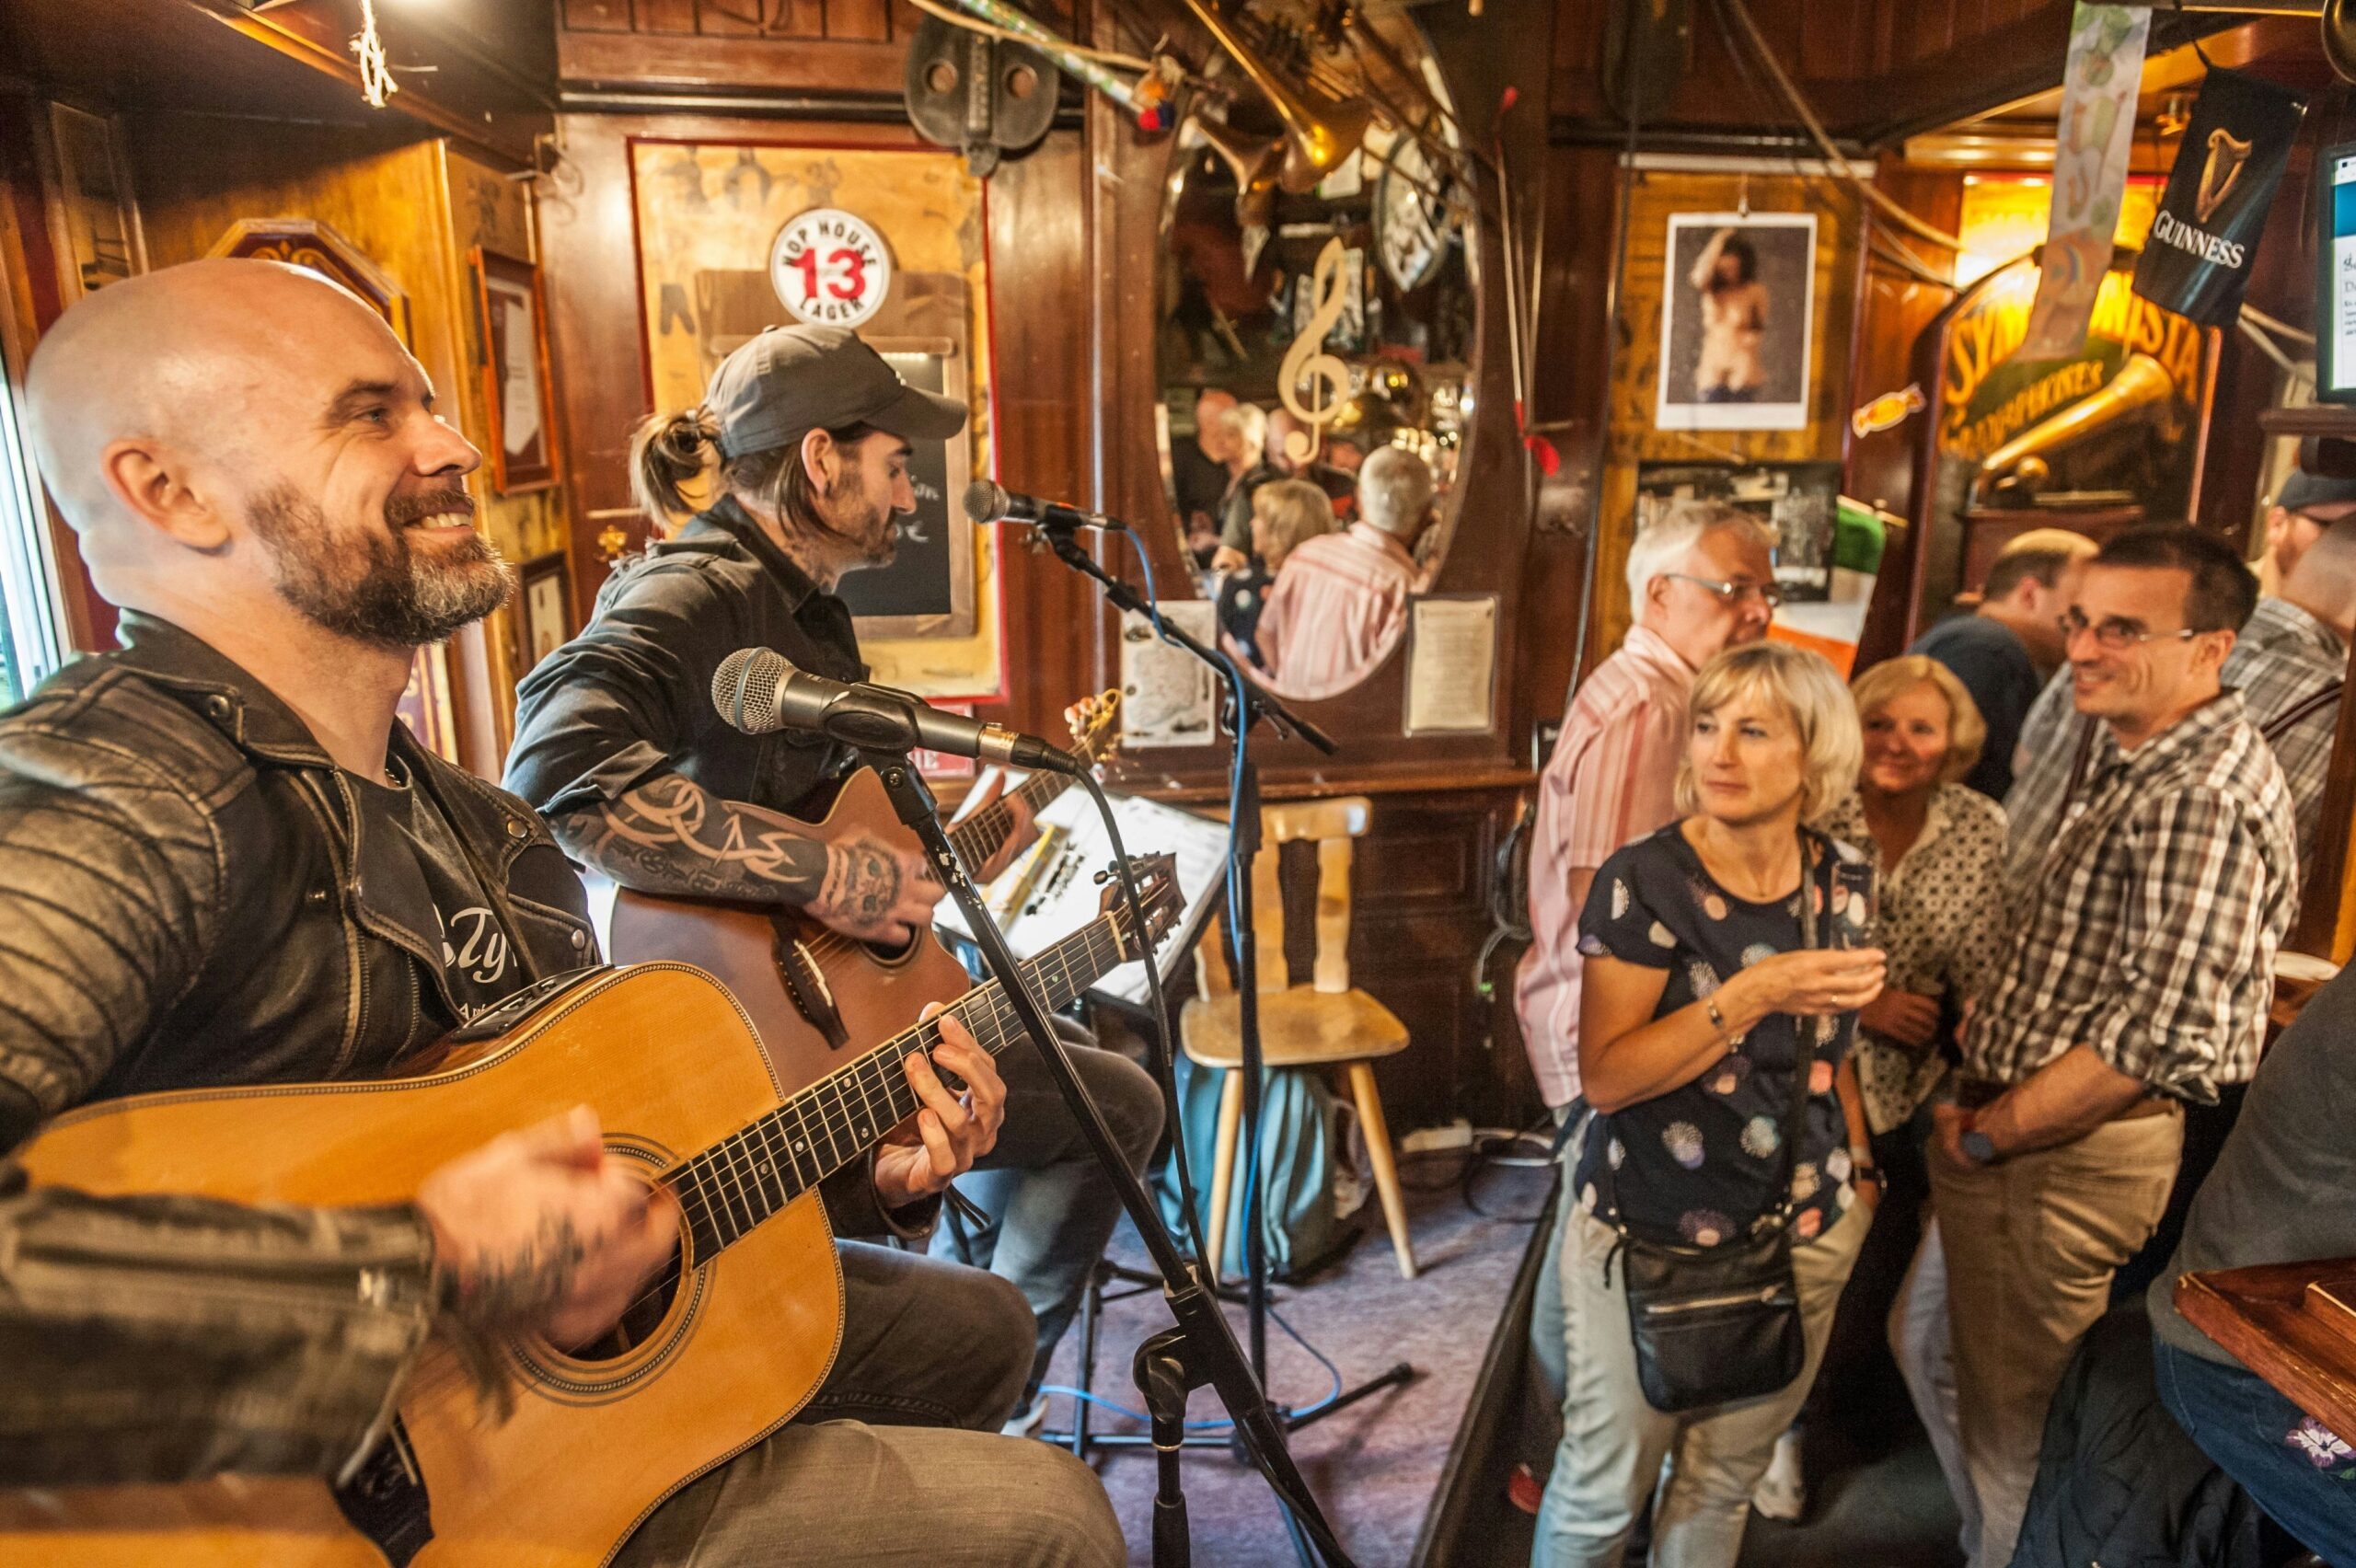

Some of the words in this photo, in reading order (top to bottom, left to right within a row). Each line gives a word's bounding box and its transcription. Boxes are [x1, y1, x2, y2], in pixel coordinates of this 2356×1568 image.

[783, 229, 807, 267] HOP
[818, 221, 876, 267] HOUSE
[2153, 209, 2245, 269] GUINNESS
[793, 248, 866, 299] 13
[800, 296, 863, 319] LAGER
